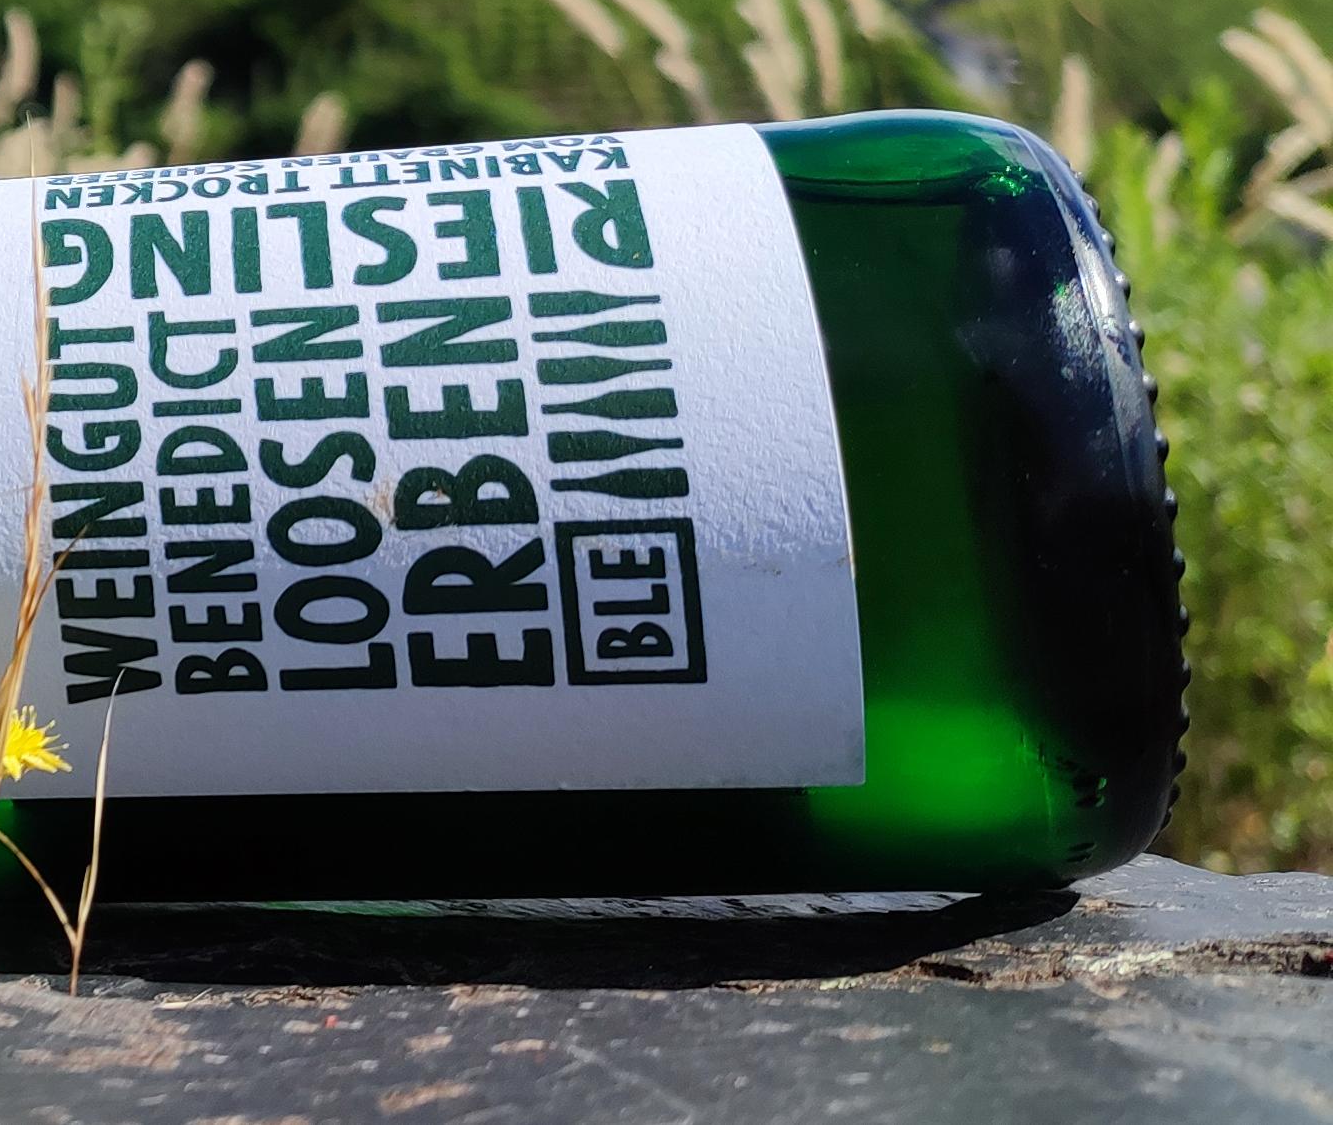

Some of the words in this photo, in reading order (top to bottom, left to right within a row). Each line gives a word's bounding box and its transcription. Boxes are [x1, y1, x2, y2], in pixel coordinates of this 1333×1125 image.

[45, 171, 310, 210] TROCKEN
[46, 161, 264, 185] SCHIEFER
[281, 145, 484, 168] GRAUEN
[331, 147, 630, 189] KABINETT
[501, 135, 623, 151] VOM
[41, 180, 654, 307] RIESLING
[46, 318, 163, 705] WEINGUT
[148, 311, 265, 695] BENEDICT
[250, 305, 398, 691] LOOSEN
[376, 296, 556, 687] ERBEN
[588, 545, 674, 661] BLE
